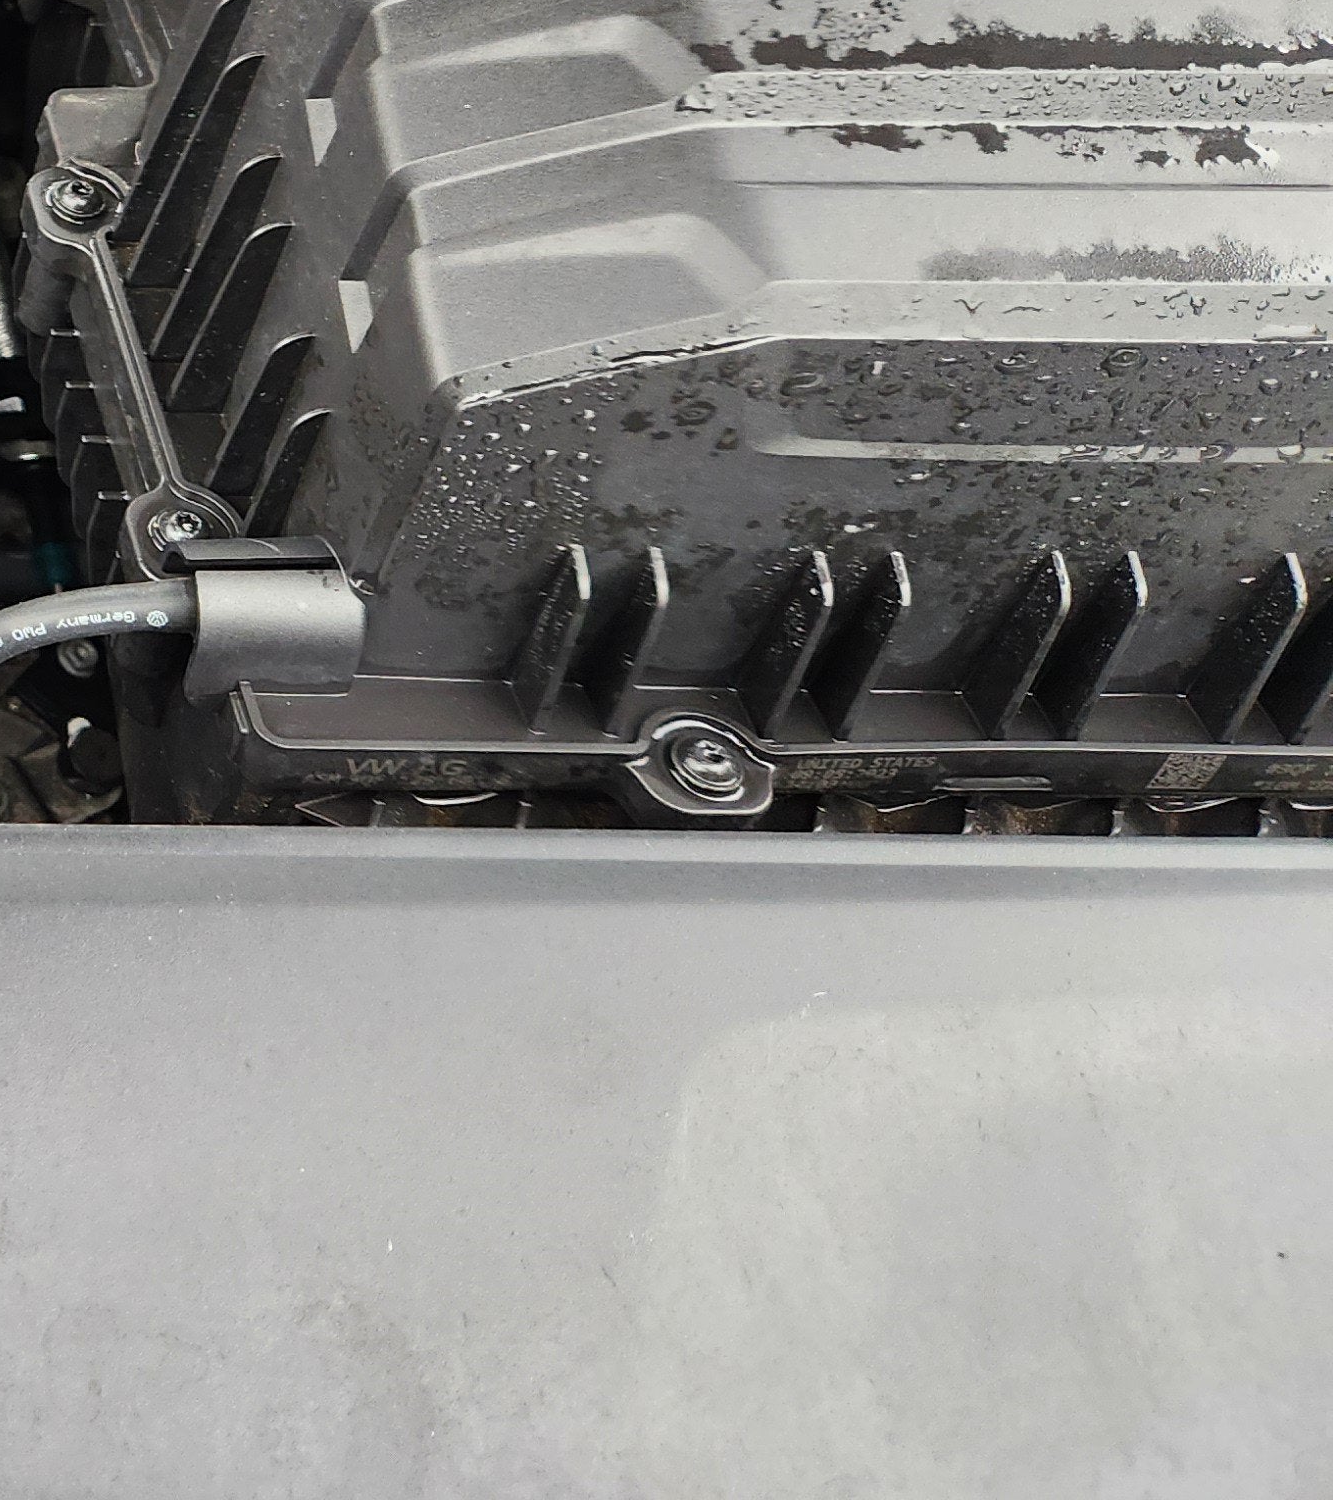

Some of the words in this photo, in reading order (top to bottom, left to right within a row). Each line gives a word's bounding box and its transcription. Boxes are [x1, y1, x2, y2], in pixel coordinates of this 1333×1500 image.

[56, 610, 137, 630] Germany
[797, 757, 864, 770] UNITED
[869, 755, 937, 769] STATES
